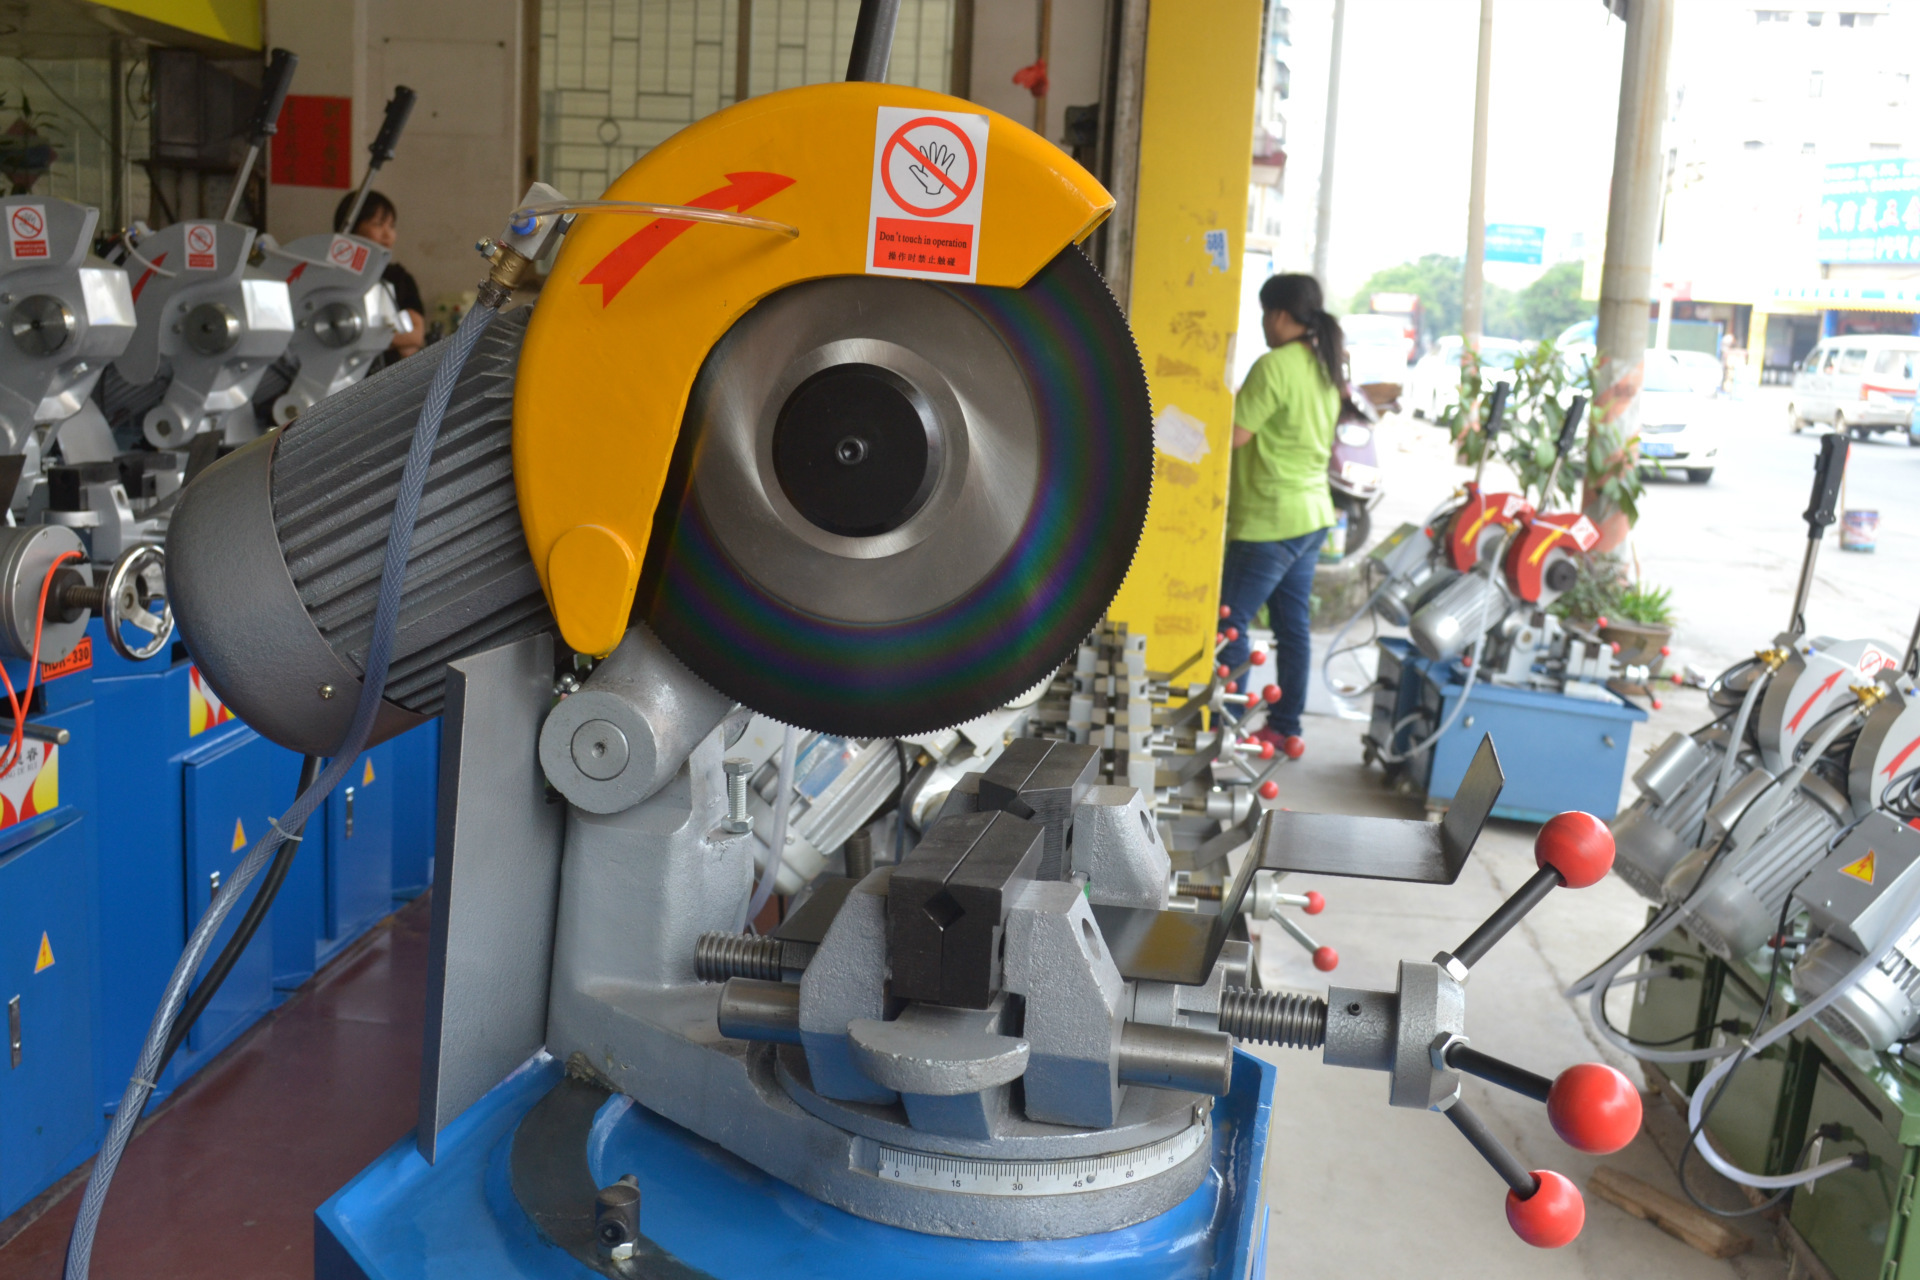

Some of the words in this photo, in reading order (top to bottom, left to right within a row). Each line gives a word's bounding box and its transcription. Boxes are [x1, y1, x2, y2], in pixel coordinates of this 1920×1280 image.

[880, 231, 901, 241] Don't
[902, 235, 923, 245] touch
[924, 235, 931, 245] in
[932, 237, 967, 249] operation
[888, 251, 956, 266] 操作时禁止触碰
[894, 1170, 900, 1178] 0
[951, 1180, 961, 1188] 15
[1012, 1183, 1023, 1191] 30
[1073, 1180, 1083, 1188] 45
[1125, 1170, 1134, 1178] 60
[1167, 1155, 1175, 1164] 75
